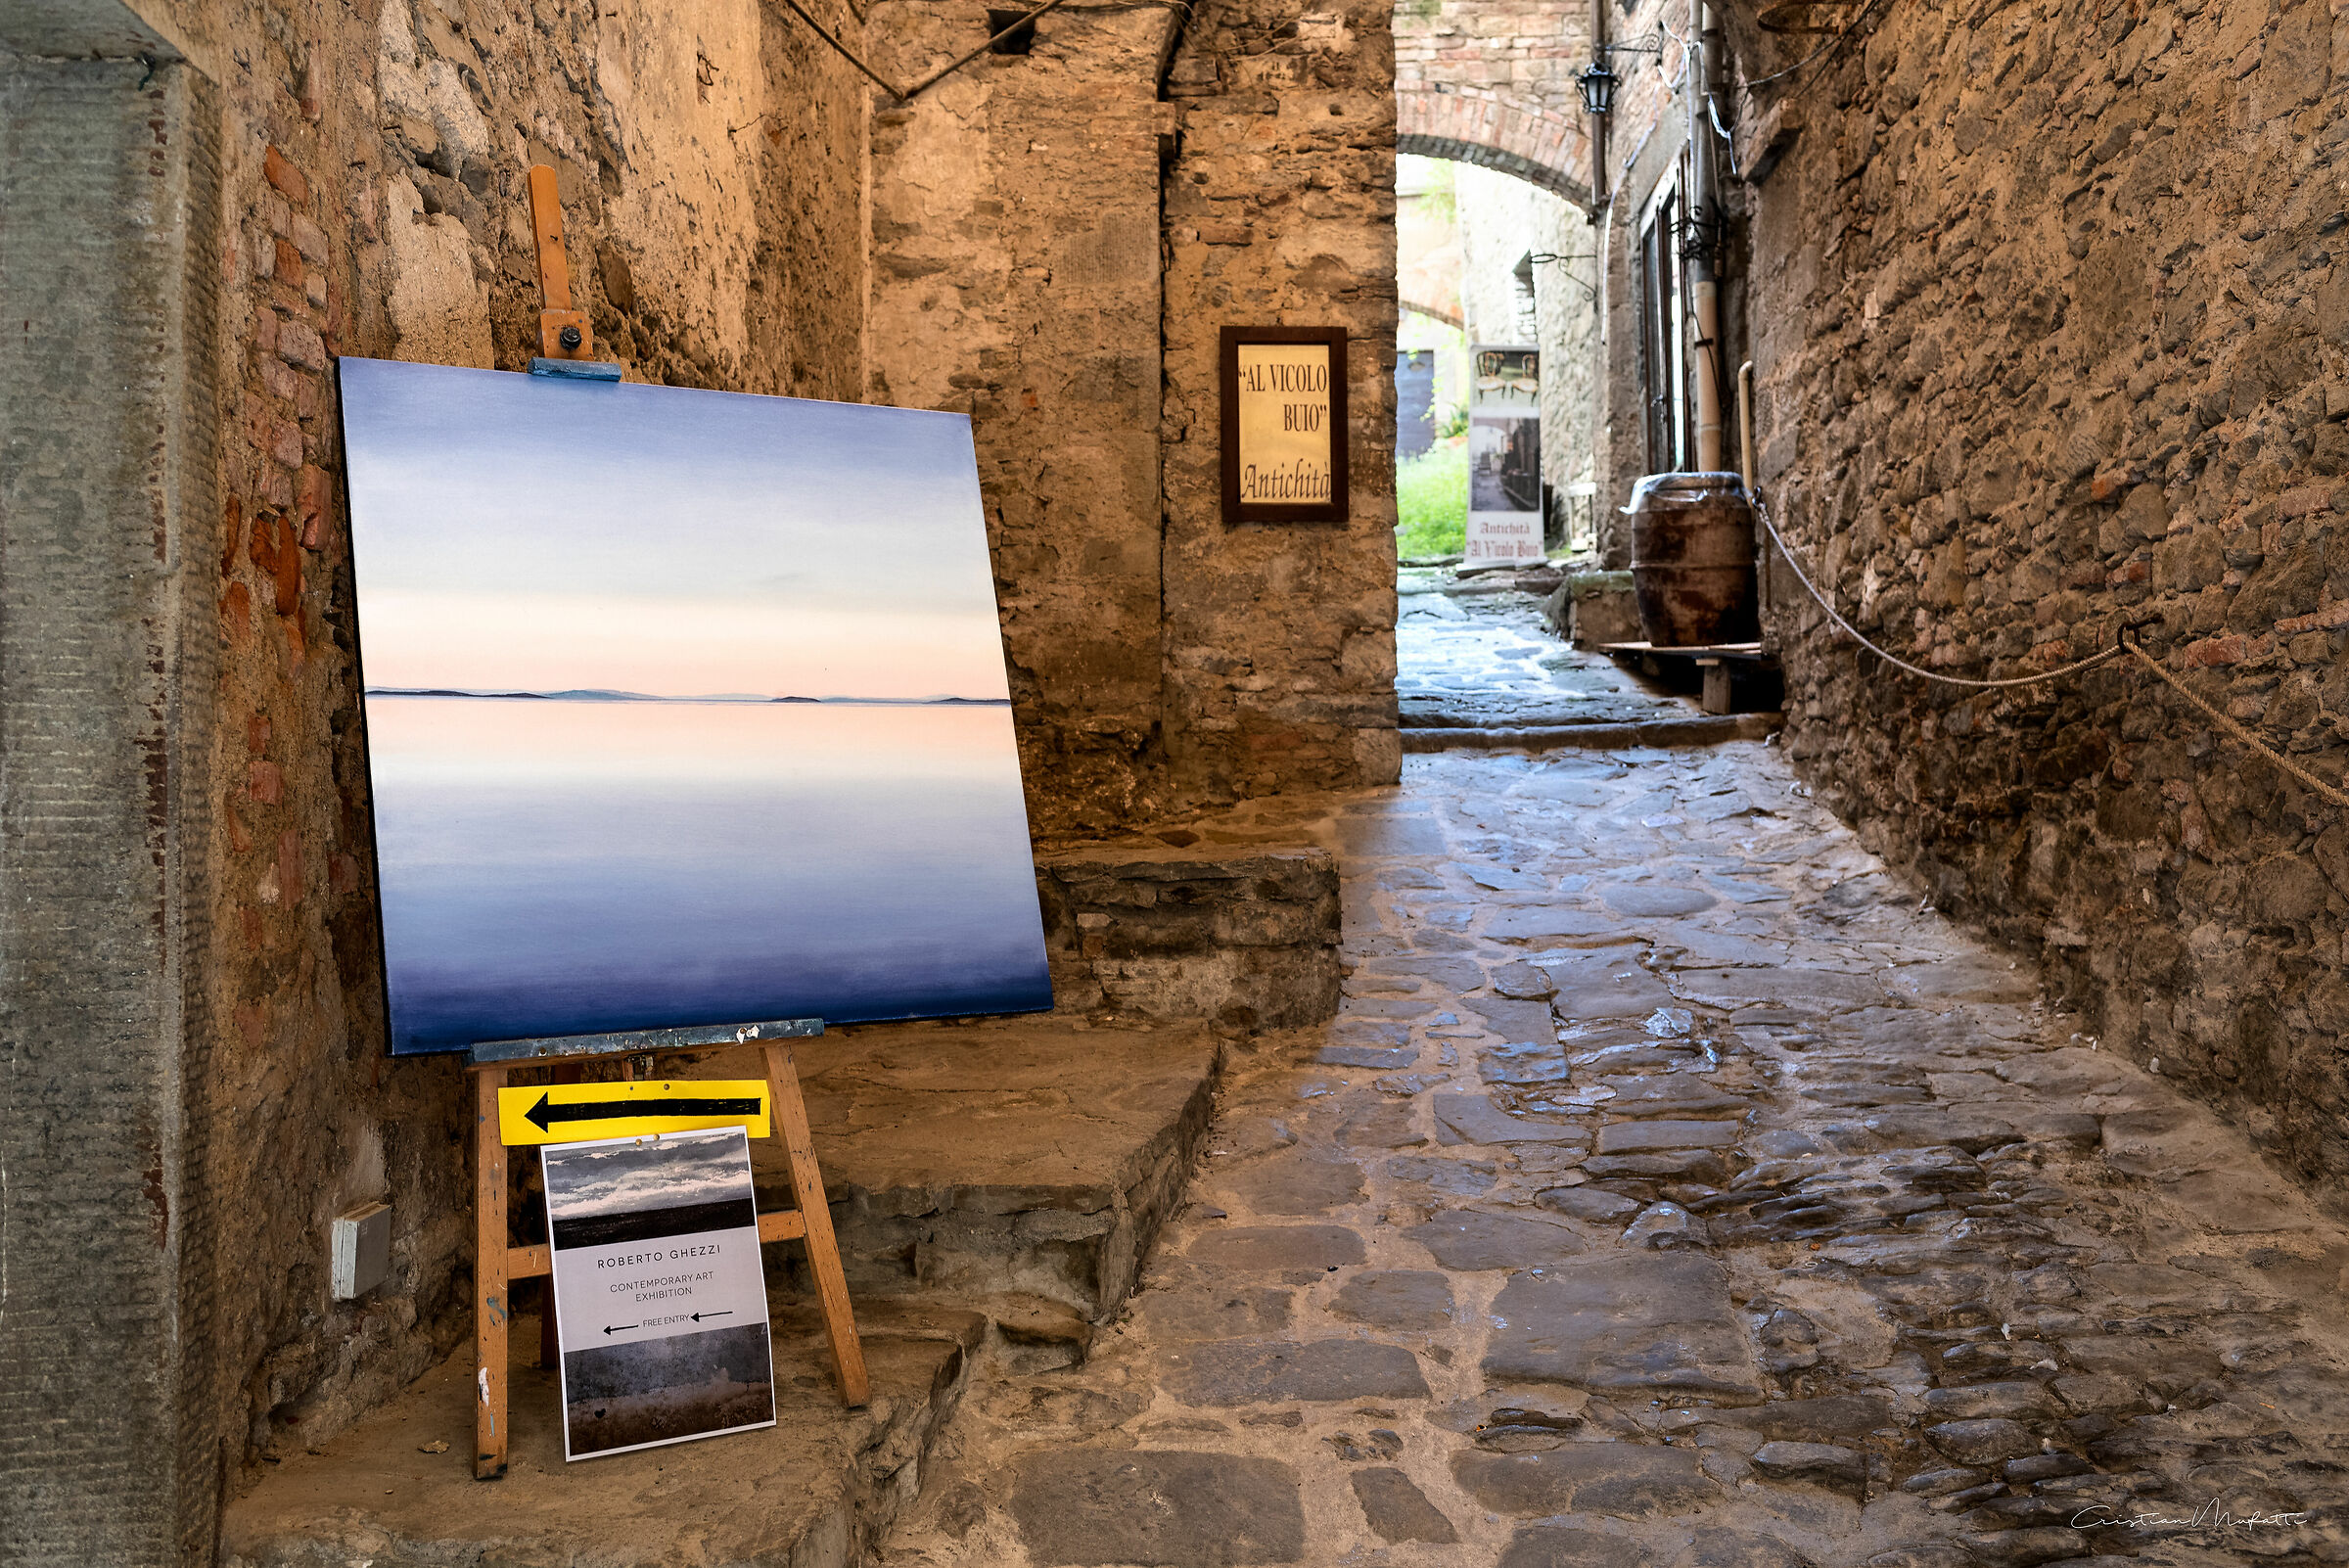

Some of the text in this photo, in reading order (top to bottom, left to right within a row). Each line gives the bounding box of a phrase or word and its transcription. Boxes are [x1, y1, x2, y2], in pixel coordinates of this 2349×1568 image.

[1269, 364, 1327, 392] VICOLO
[1241, 458, 1331, 499] Antichità
[597, 1244, 721, 1269] ROBERTO GHEZZI
[610, 1270, 714, 1293] CONTEMPORARY ART
[635, 1286, 693, 1303] EXHIBITION
[642, 1314, 690, 1328] FREE ENTRY
